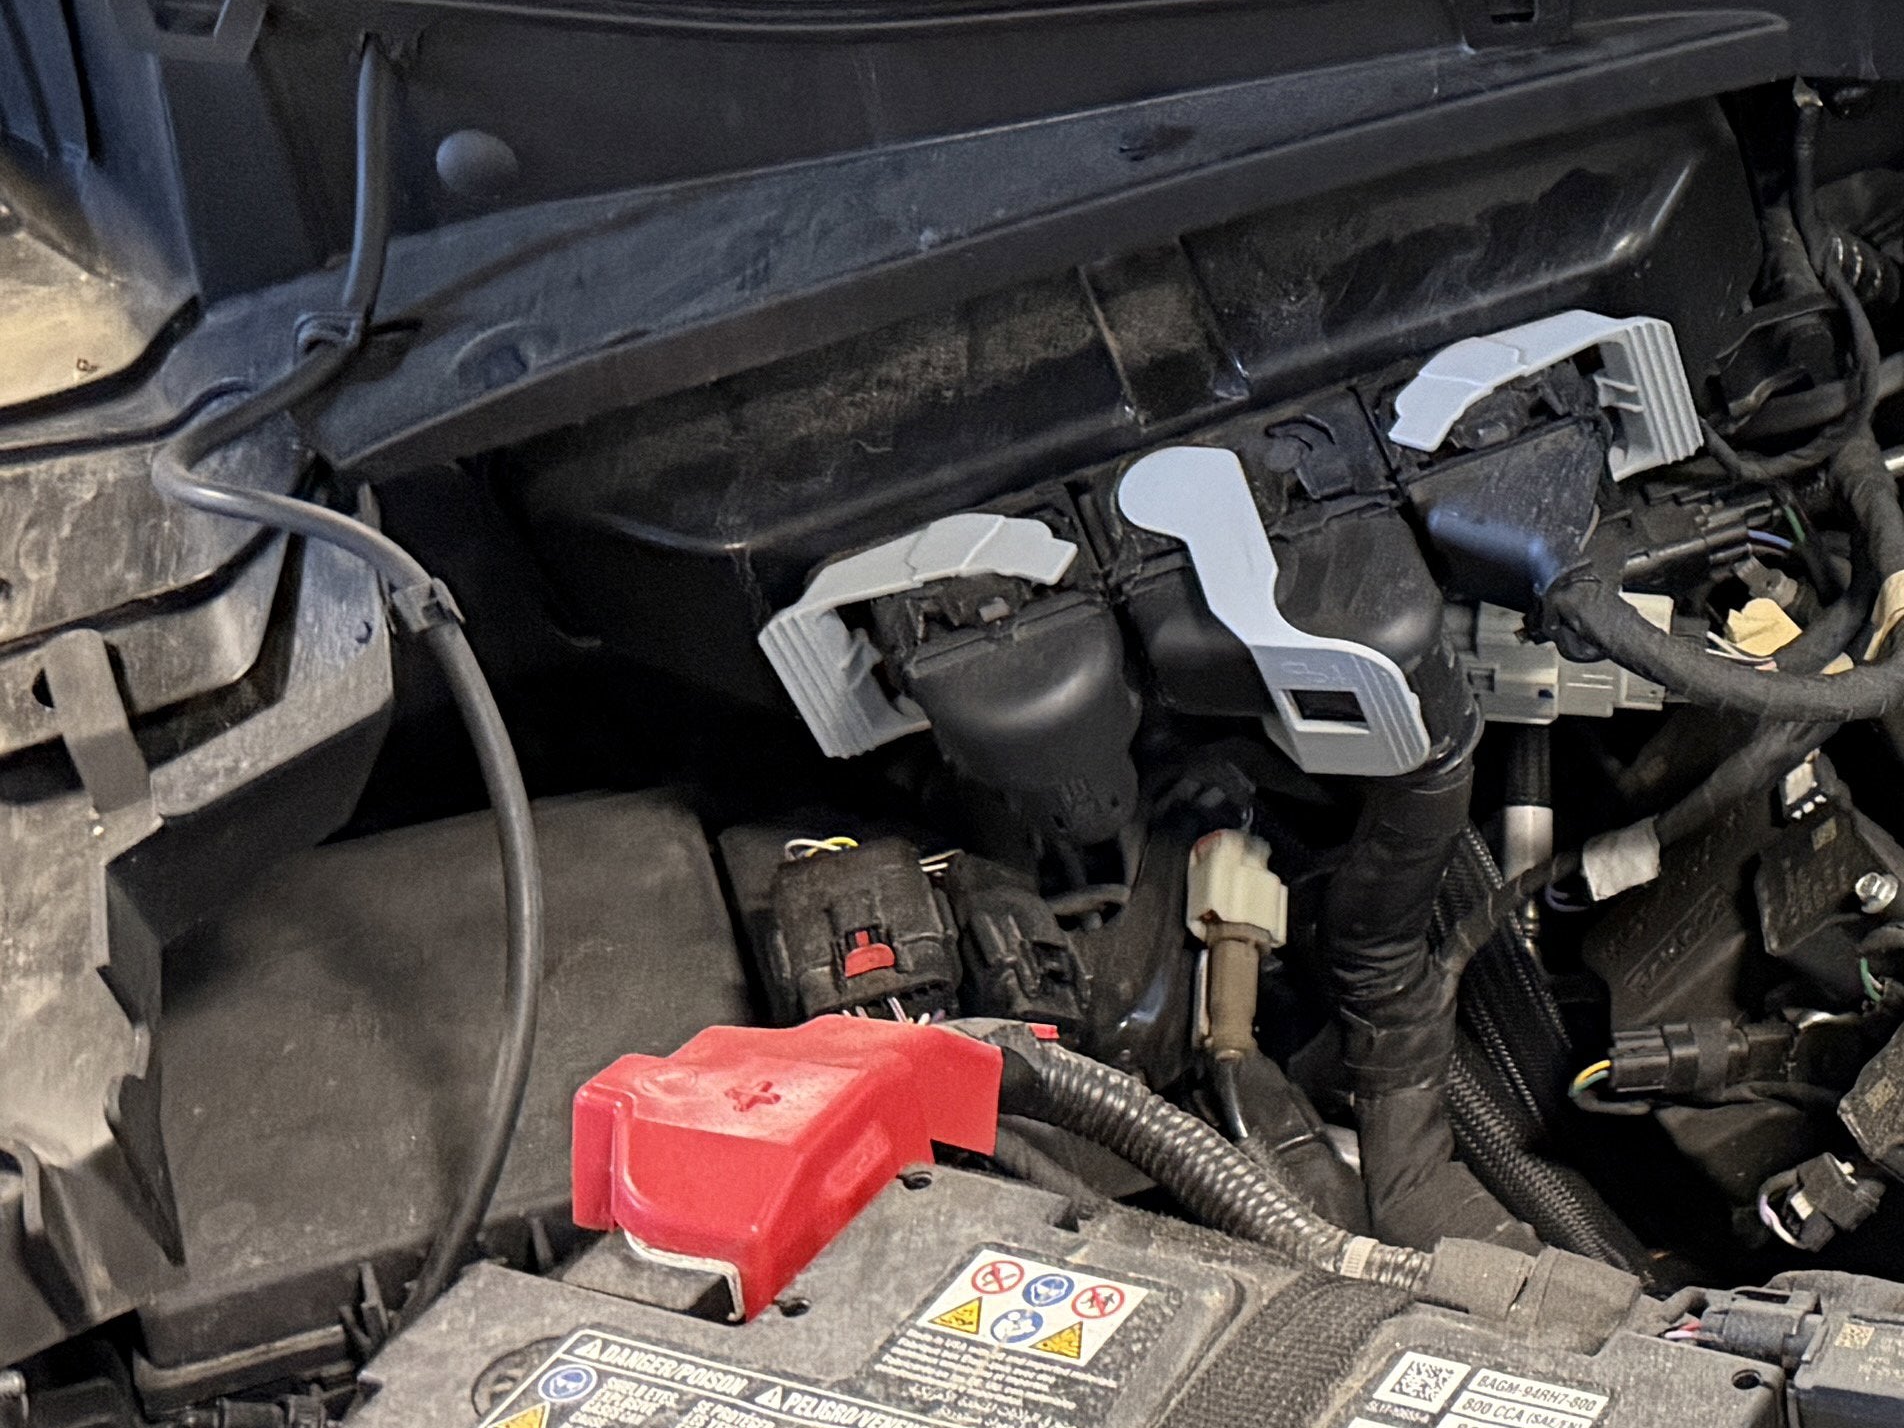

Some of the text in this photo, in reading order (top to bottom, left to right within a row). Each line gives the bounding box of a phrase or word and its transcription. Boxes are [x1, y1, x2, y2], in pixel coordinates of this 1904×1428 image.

[596, 1345, 750, 1395] DANGER/POISON
[1461, 1397, 1493, 1414] 800
[1492, 1405, 1525, 1422] CCA
